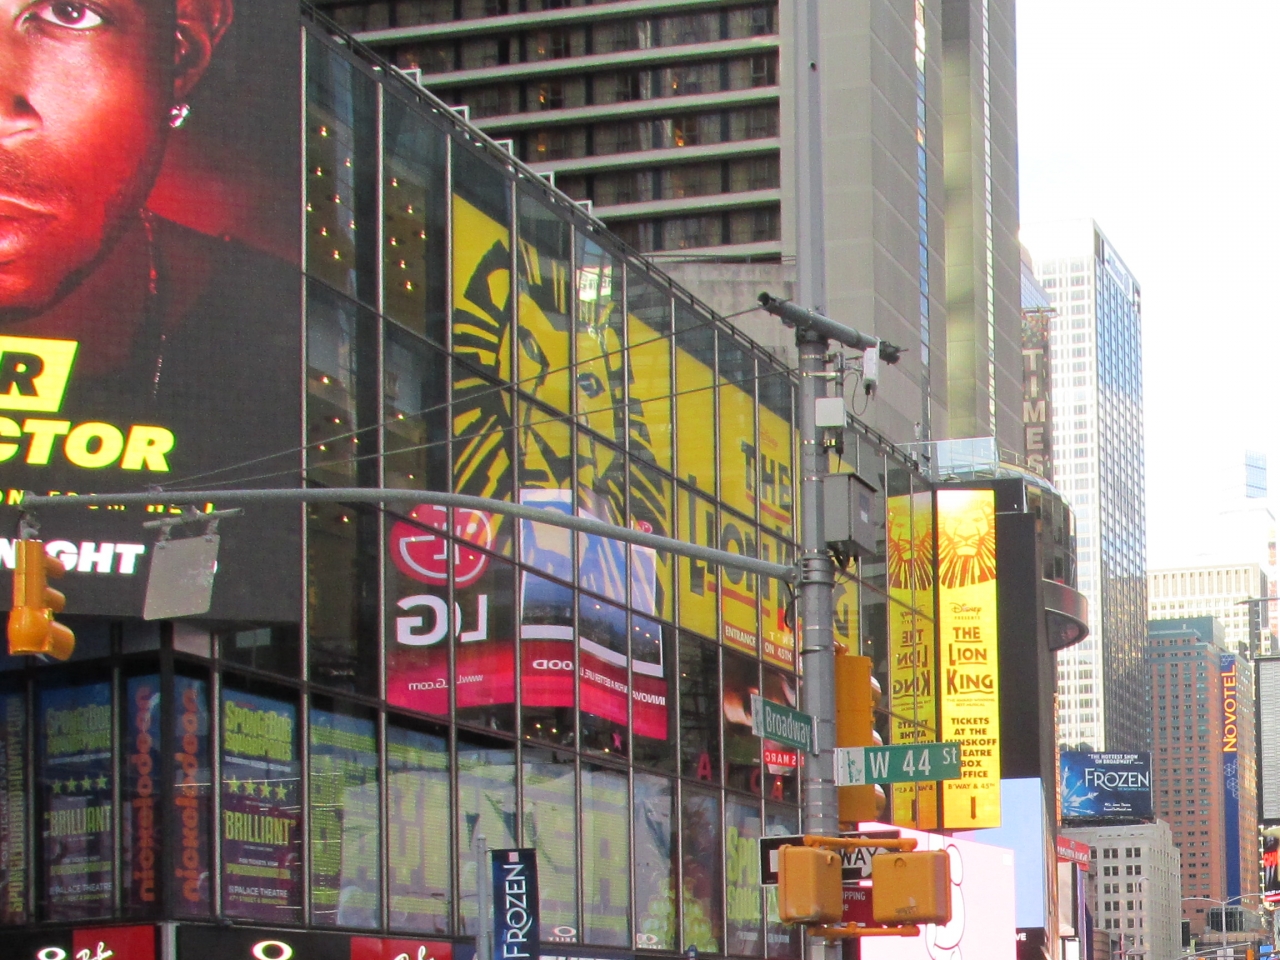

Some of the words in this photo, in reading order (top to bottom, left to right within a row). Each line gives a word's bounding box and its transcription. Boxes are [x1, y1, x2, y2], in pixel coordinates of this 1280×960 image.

[741, 440, 793, 513] THE
[950, 602, 982, 616] Disney
[725, 624, 757, 649] ENTRANCE
[953, 626, 981, 640] THE
[764, 641, 775, 655] ON
[948, 643, 987, 666] LION
[946, 668, 994, 696] KING
[1222, 665, 1238, 752] NOVOTEL
[766, 705, 811, 750] Broadway
[951, 717, 990, 725] TICKETS
[870, 751, 889, 778] W
[902, 749, 931, 777] 44
[943, 744, 957, 765] St
[961, 749, 992, 757] EATRE
[1085, 768, 1150, 791] FROZEN
[260, 886, 288, 898] THEATRE
[503, 864, 533, 959] FROZEN
